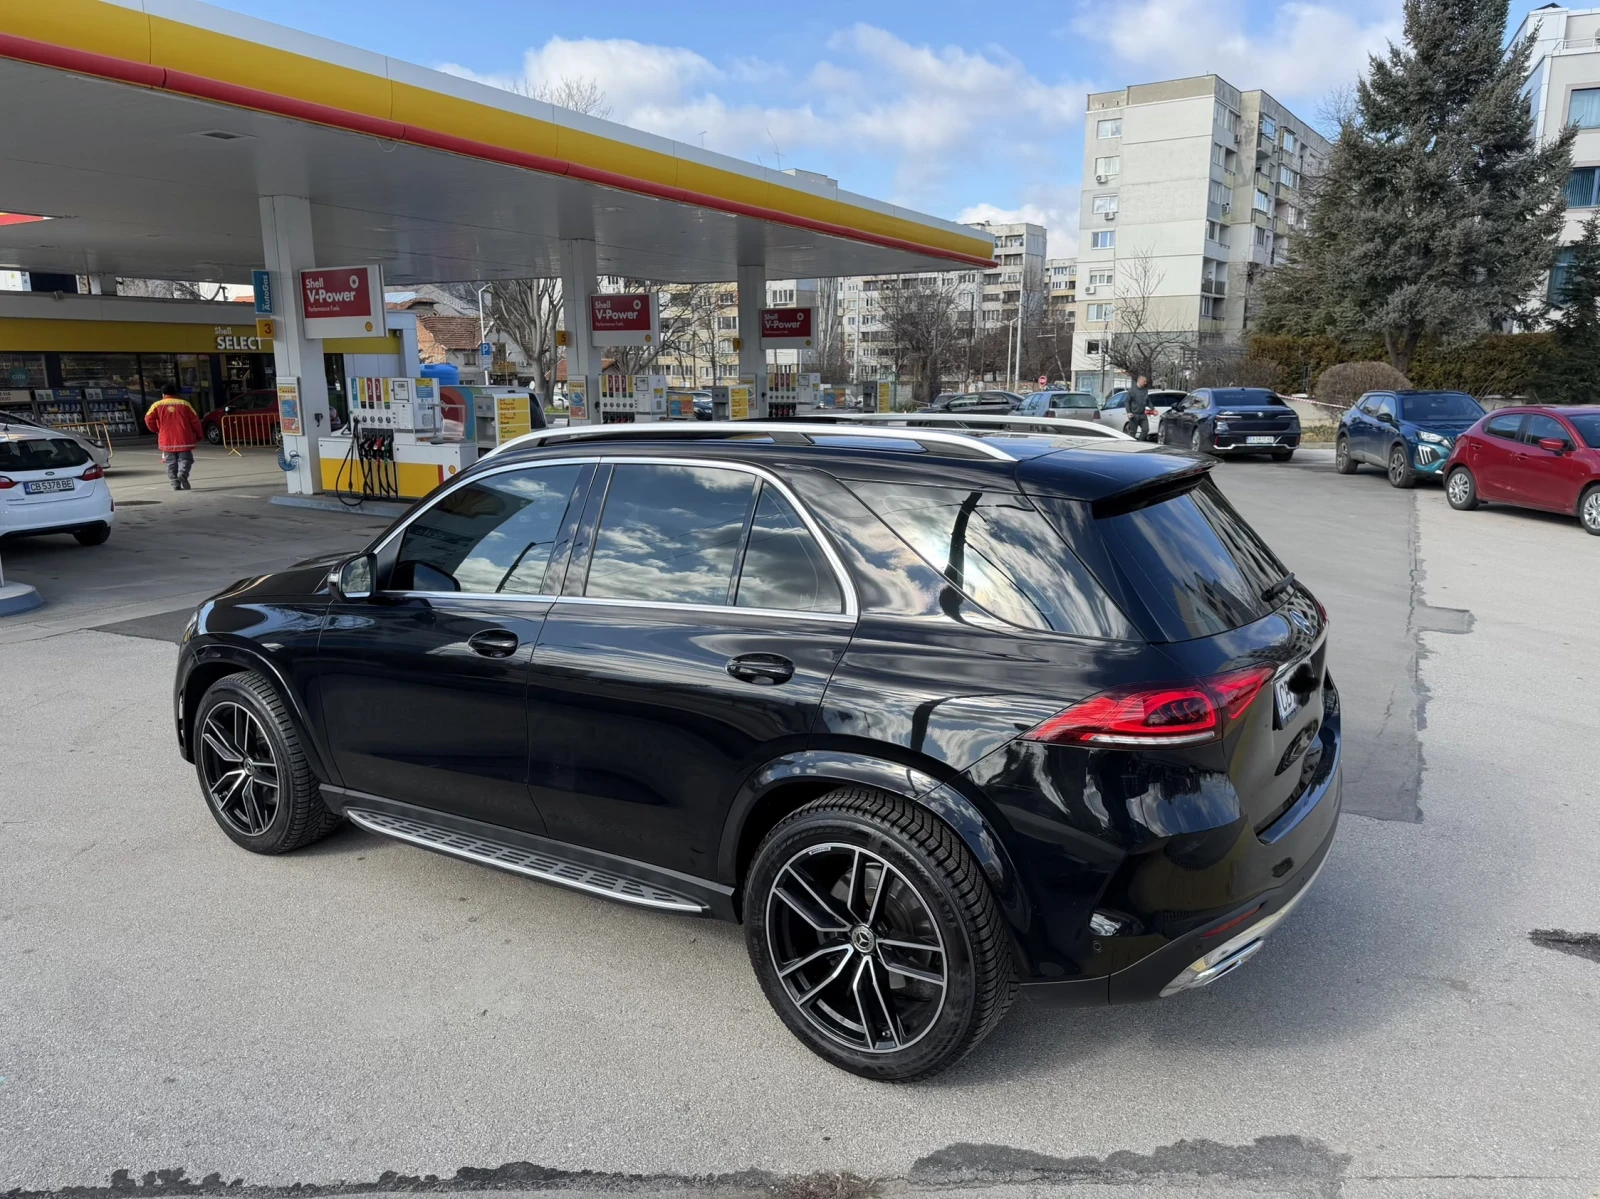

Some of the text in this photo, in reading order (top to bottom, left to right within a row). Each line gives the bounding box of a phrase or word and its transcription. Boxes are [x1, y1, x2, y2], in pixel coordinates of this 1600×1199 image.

[306, 277, 324, 289] Shell
[263, 275, 271, 310] AutoGas
[307, 289, 356, 304] V-Power
[595, 301, 611, 309] Shell
[596, 309, 638, 320] V-Power
[264, 323, 272, 335] 3
[765, 320, 801, 329] V-Power
[215, 327, 232, 335] Shell
[217, 336, 262, 350] SELECT
[561, 334, 566, 342] 5
[30, 483, 42, 492] CB
[42, 481, 61, 490] 5378
[62, 480, 73, 488] BE
